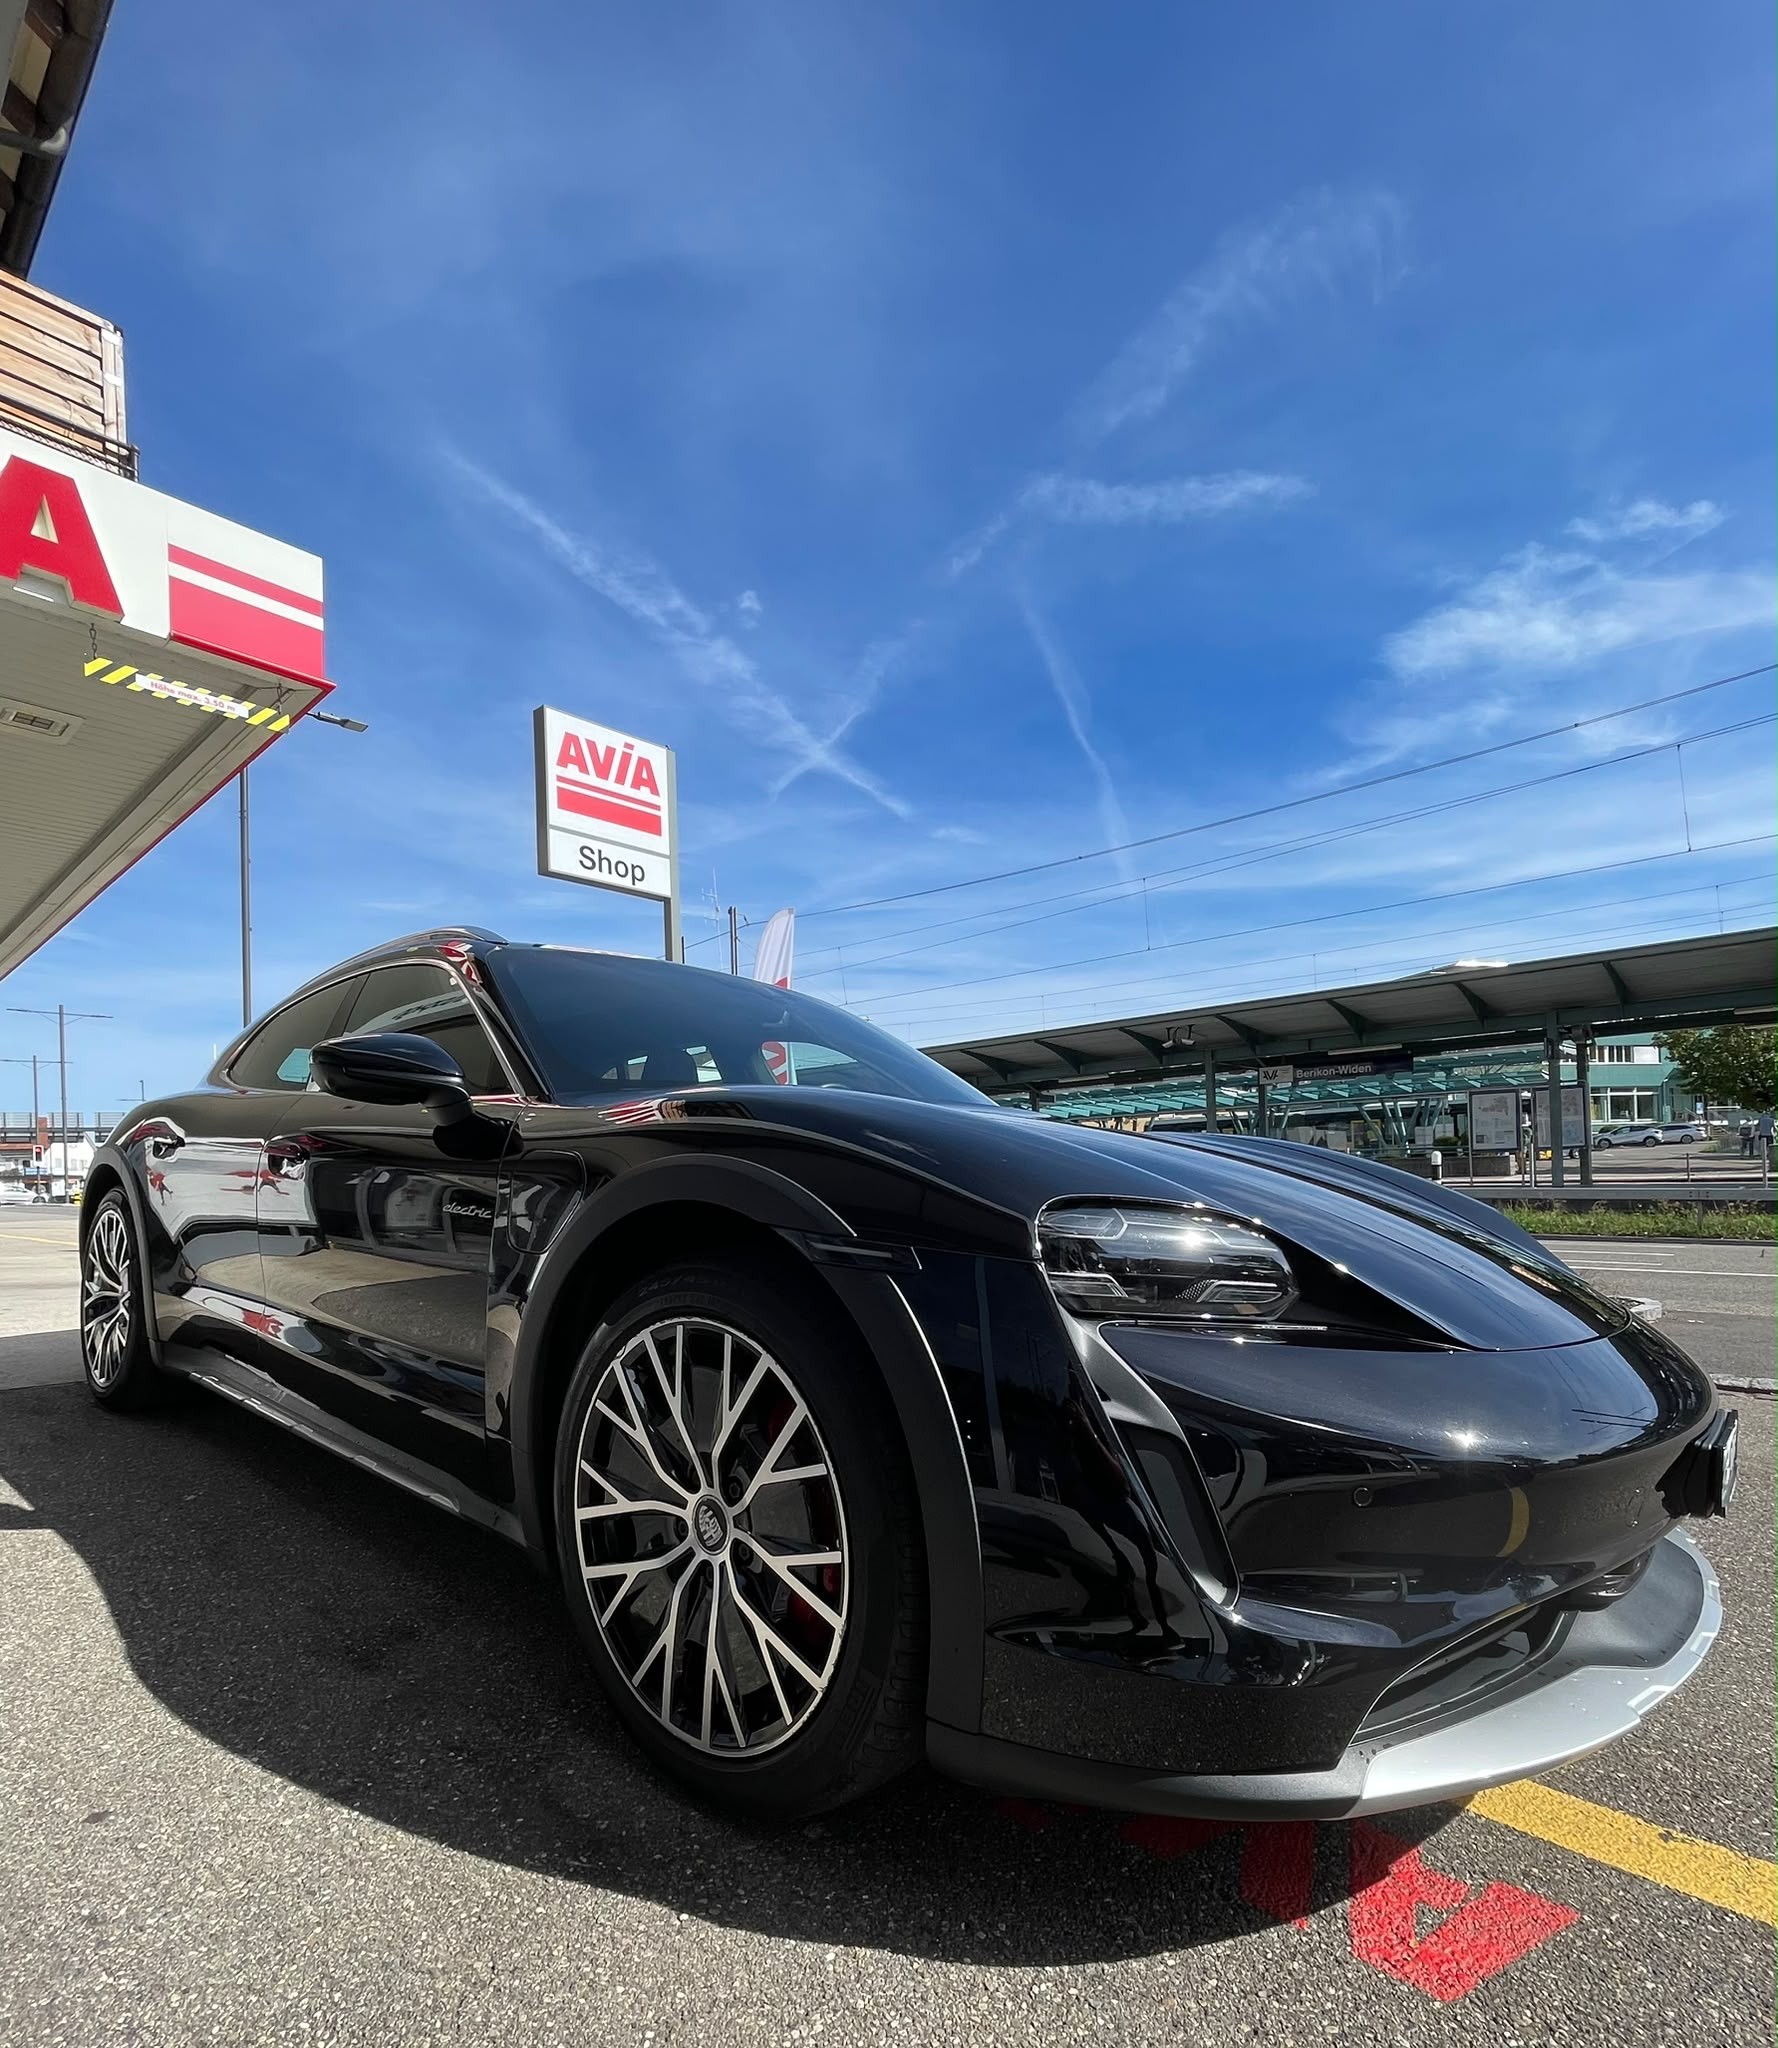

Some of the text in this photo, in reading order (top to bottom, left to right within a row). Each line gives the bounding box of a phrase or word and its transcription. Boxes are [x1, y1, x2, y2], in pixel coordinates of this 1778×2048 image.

[150, 681, 175, 694] Höhe
[227, 704, 236, 712] m
[578, 845, 646, 885] Shop
[1296, 1063, 1372, 1079] Berikon-Widen
[442, 1201, 492, 1218] electric
